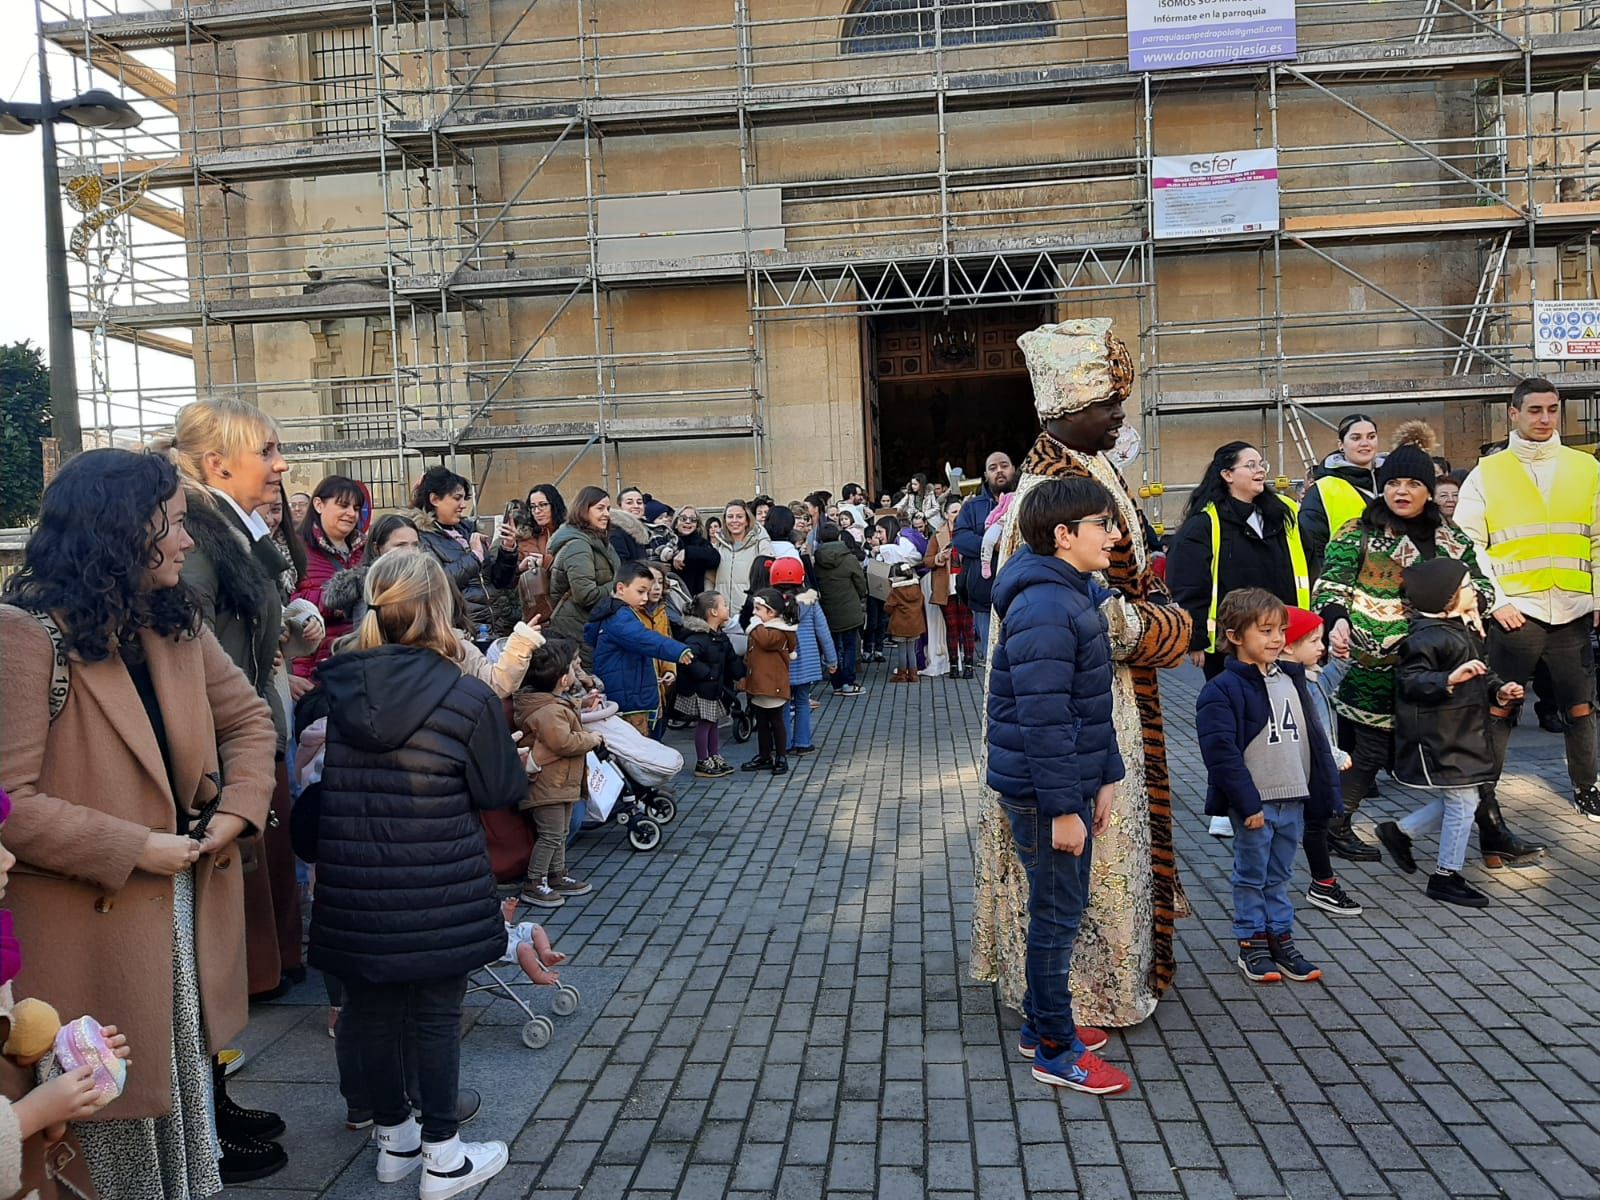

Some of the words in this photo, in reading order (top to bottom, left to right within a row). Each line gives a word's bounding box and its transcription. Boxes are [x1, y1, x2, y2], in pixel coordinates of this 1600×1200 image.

[1154, 14, 1197, 23] Infórmate
[1212, 9, 1220, 18] la
[1222, 7, 1266, 20] parroquia
[1142, 25, 1282, 44] parroquiasanpedropola@gmail.com
[1143, 43, 1282, 63] www.donoamiiglesia.es
[1190, 155, 1237, 174] esfer
[1267, 698, 1300, 745] 14
